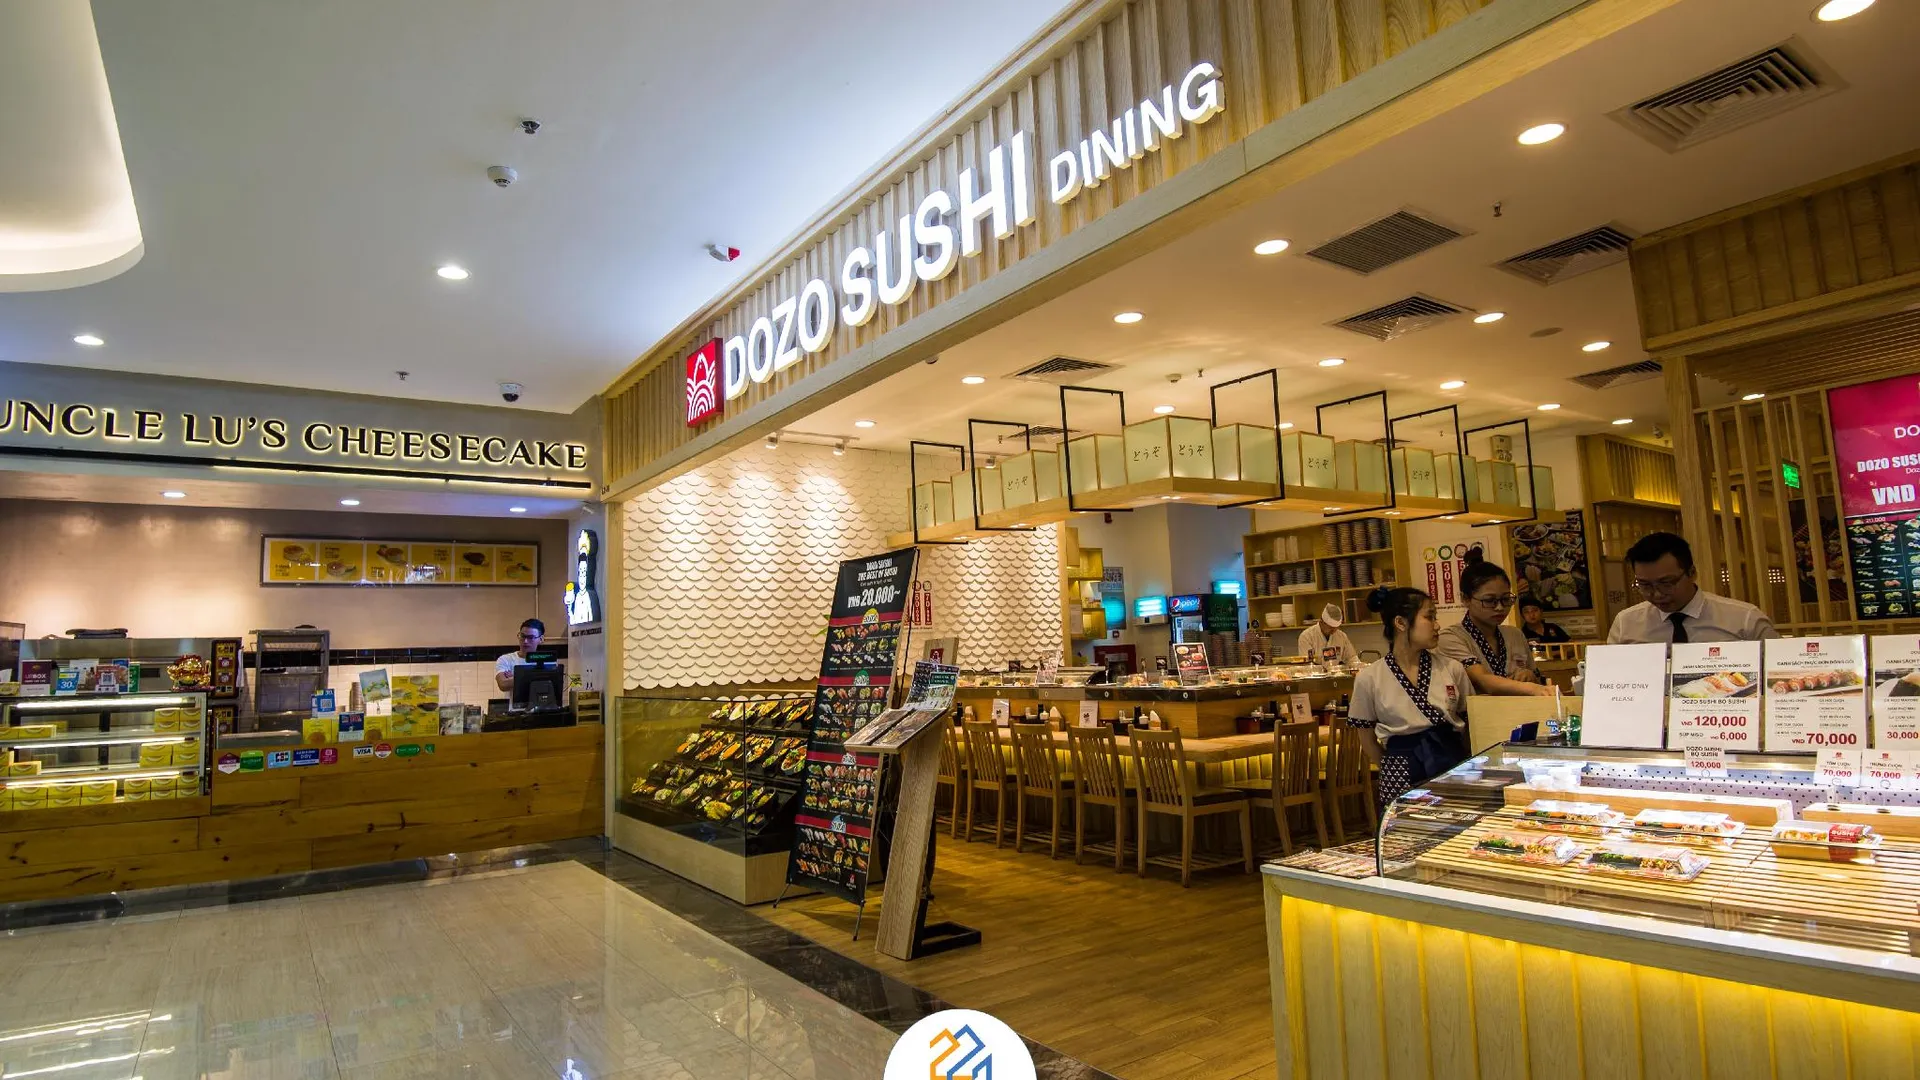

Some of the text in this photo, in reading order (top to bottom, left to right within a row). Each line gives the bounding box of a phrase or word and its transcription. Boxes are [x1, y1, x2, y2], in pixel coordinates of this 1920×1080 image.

[725, 61, 1225, 400] DOZO SUSHI DINING
[183, 413, 286, 448] LU'S
[303, 423, 588, 469] CHEESECAKE
[1857, 458, 1889, 473] DOZO
[1872, 484, 1916, 505] VND
[1694, 716, 1747, 728] 120,000
[1720, 732, 1747, 741] 6,000
[1806, 733, 1857, 746] 70,000
[1887, 731, 1919, 740] 30,000
[1690, 760, 1721, 769] 120,000
[1823, 769, 1852, 777] 70,000
[1870, 771, 1901, 779] 70,000
